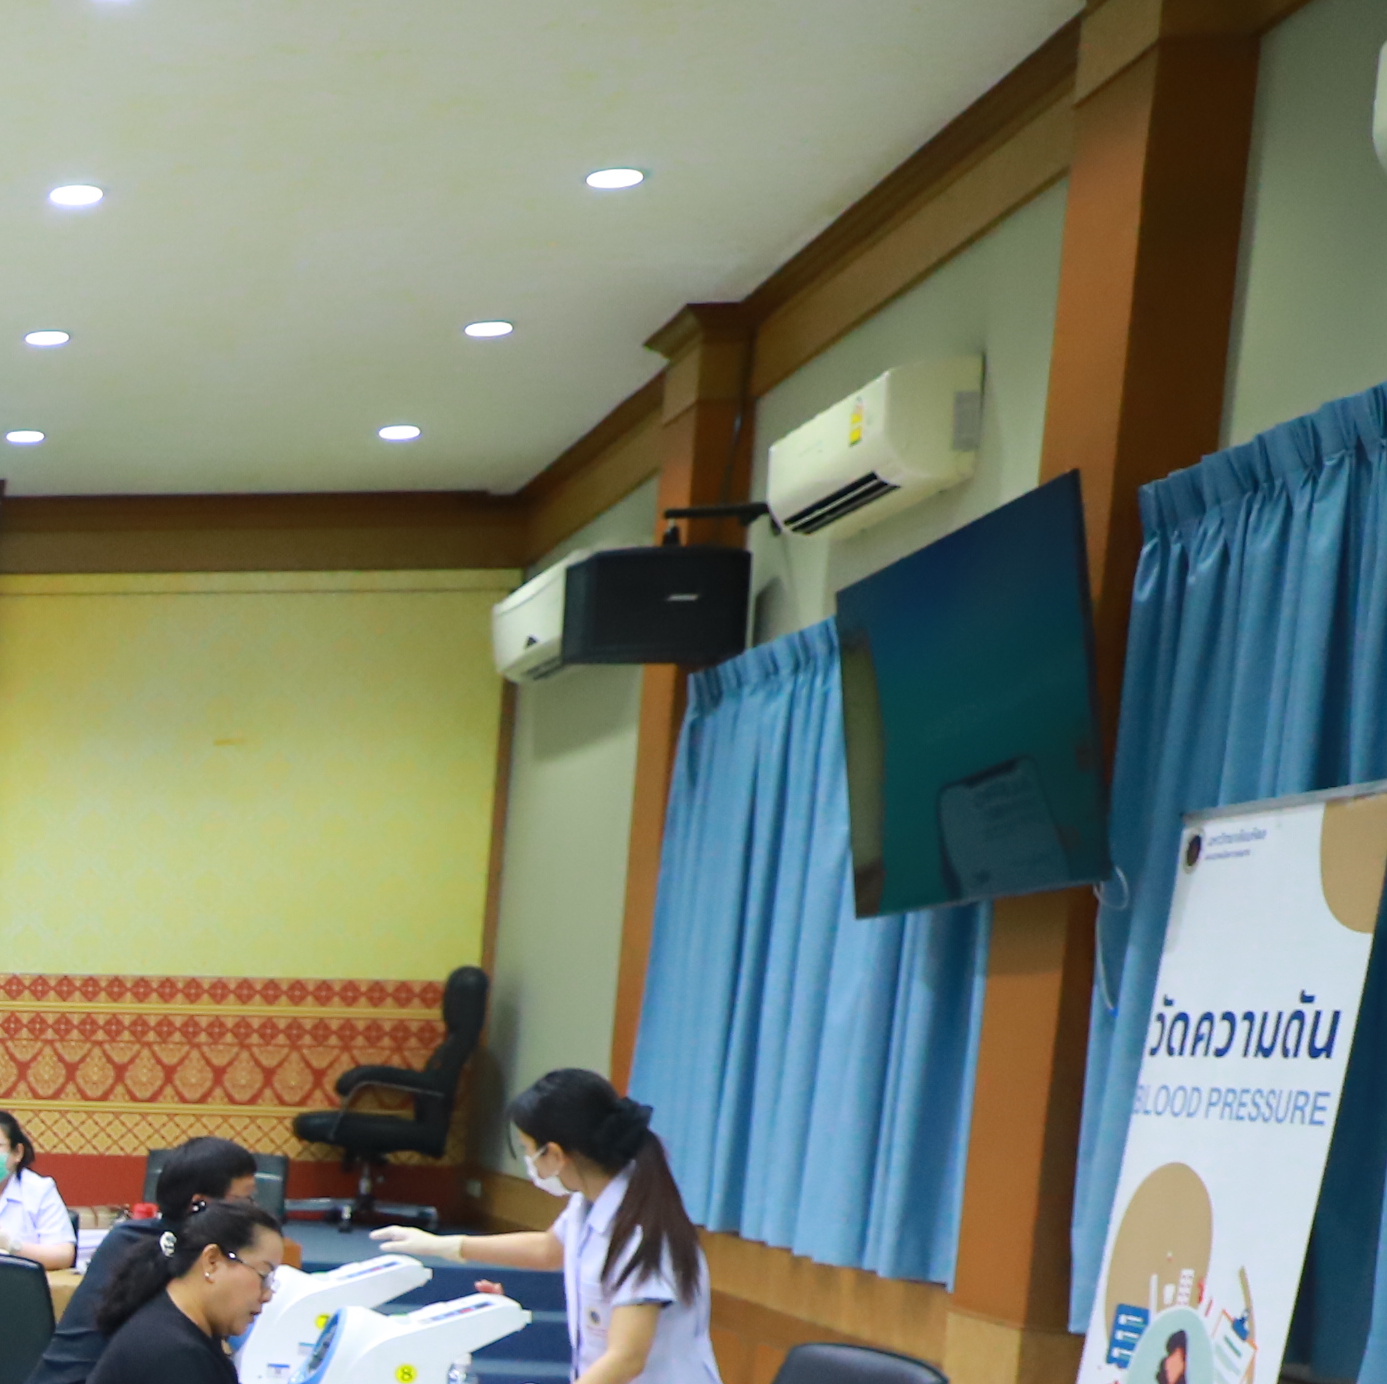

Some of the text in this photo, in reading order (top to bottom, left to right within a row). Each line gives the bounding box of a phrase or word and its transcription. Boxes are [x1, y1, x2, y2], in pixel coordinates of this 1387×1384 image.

[1148, 989, 1342, 1059] วัดความดัน
[1133, 1084, 1331, 1127] BLOOD PRESSURE
